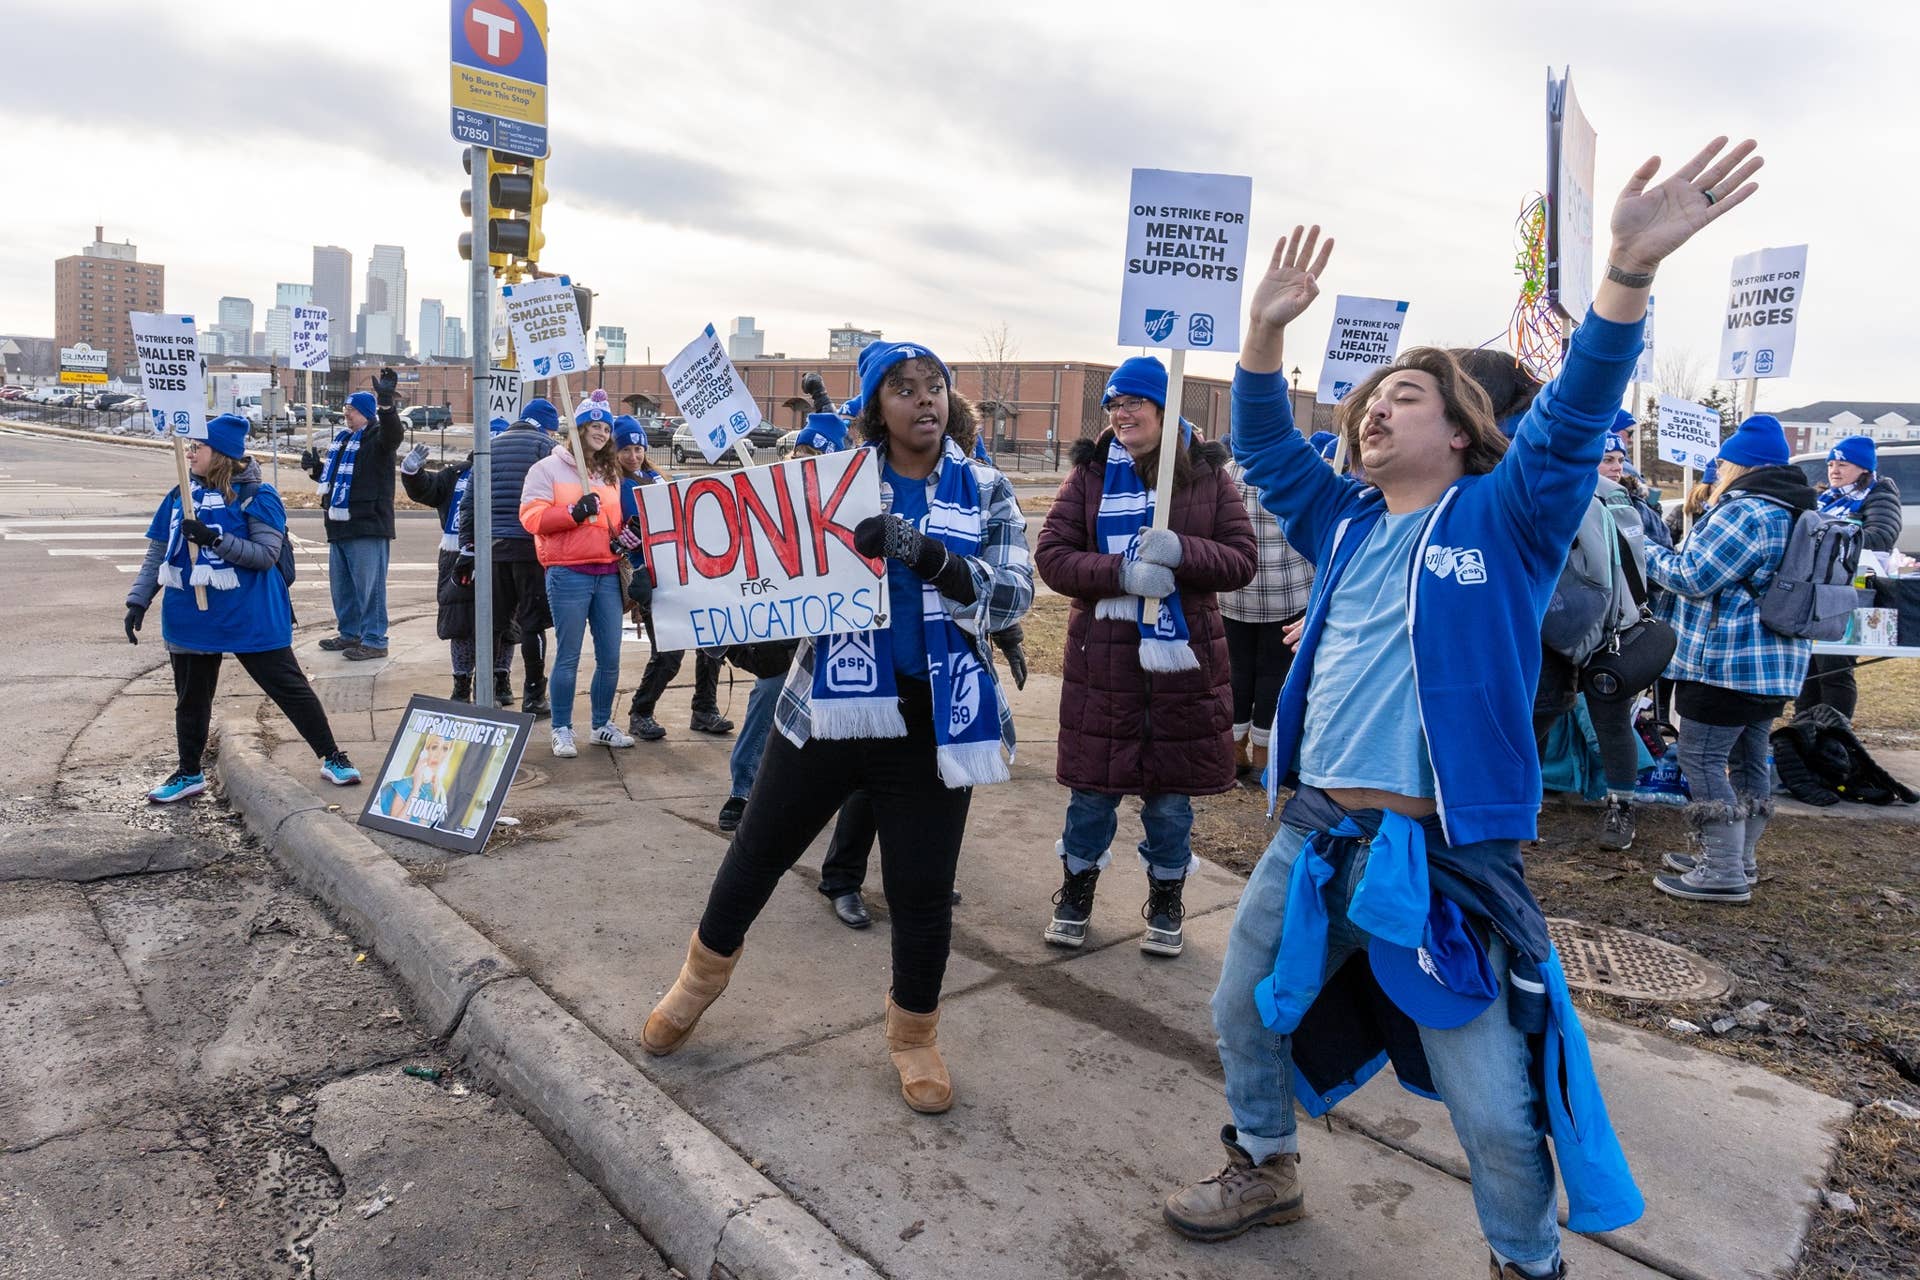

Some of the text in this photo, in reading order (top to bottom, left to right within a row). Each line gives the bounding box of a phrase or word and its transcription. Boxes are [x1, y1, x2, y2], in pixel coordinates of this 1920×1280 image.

[472, 8, 515, 58] T
[461, 72, 537, 98] No Buses Currently
[469, 85, 530, 106] Serve This Stop
[466, 114, 483, 126] Stop
[457, 125, 489, 141] 17850
[1134, 205, 1244, 224] ON STRIKE FOR
[1146, 222, 1228, 244] MENTAL
[1146, 241, 1225, 262] HEALTH
[1128, 259, 1238, 282] SUPPORTS
[1732, 270, 1800, 287] ON STRIKE FOR
[509, 292, 571, 310] ON STRIKE FOR
[1731, 286, 1795, 309] LIVING
[294, 307, 327, 320] BETTER
[511, 302, 574, 323] SMALLER
[1727, 307, 1794, 329] WAGES
[304, 321, 320, 330] PAY
[523, 315, 567, 332] CLASS
[1337, 318, 1400, 331] ON STRIKE FOR
[136, 333, 194, 345] ON STRIKE FOR
[293, 331, 328, 342] FOR OUR
[529, 326, 567, 343] SIZES
[1342, 329, 1389, 342] MENTAL
[138, 346, 195, 361] SMALLER
[1340, 340, 1386, 353] HEALTH
[62, 353, 105, 362] SUMMIT
[672, 342, 720, 390] ON STRIKE FOR
[1328, 350, 1392, 365] SUPPORTS
[145, 362, 187, 376] CLASS
[675, 351, 723, 399] RECRUITMENT
[148, 377, 186, 391] SIZES
[681, 364, 731, 413] RETENTION OF
[696, 372, 713, 390] AND
[490, 395, 517, 412] AY
[688, 375, 733, 416] EDUCATORS
[695, 385, 734, 419] OF COLOR
[1662, 406, 1717, 424] ON STRIKE FOR
[1660, 429, 1717, 448] SCHOOLS
[1667, 423, 1711, 439] STABLE
[633, 448, 887, 589] HONK
[740, 578, 778, 597] FOR
[837, 655, 866, 670] esp
[951, 705, 971, 725] 59
[413, 716, 508, 746] MPS DISTRICT IS
